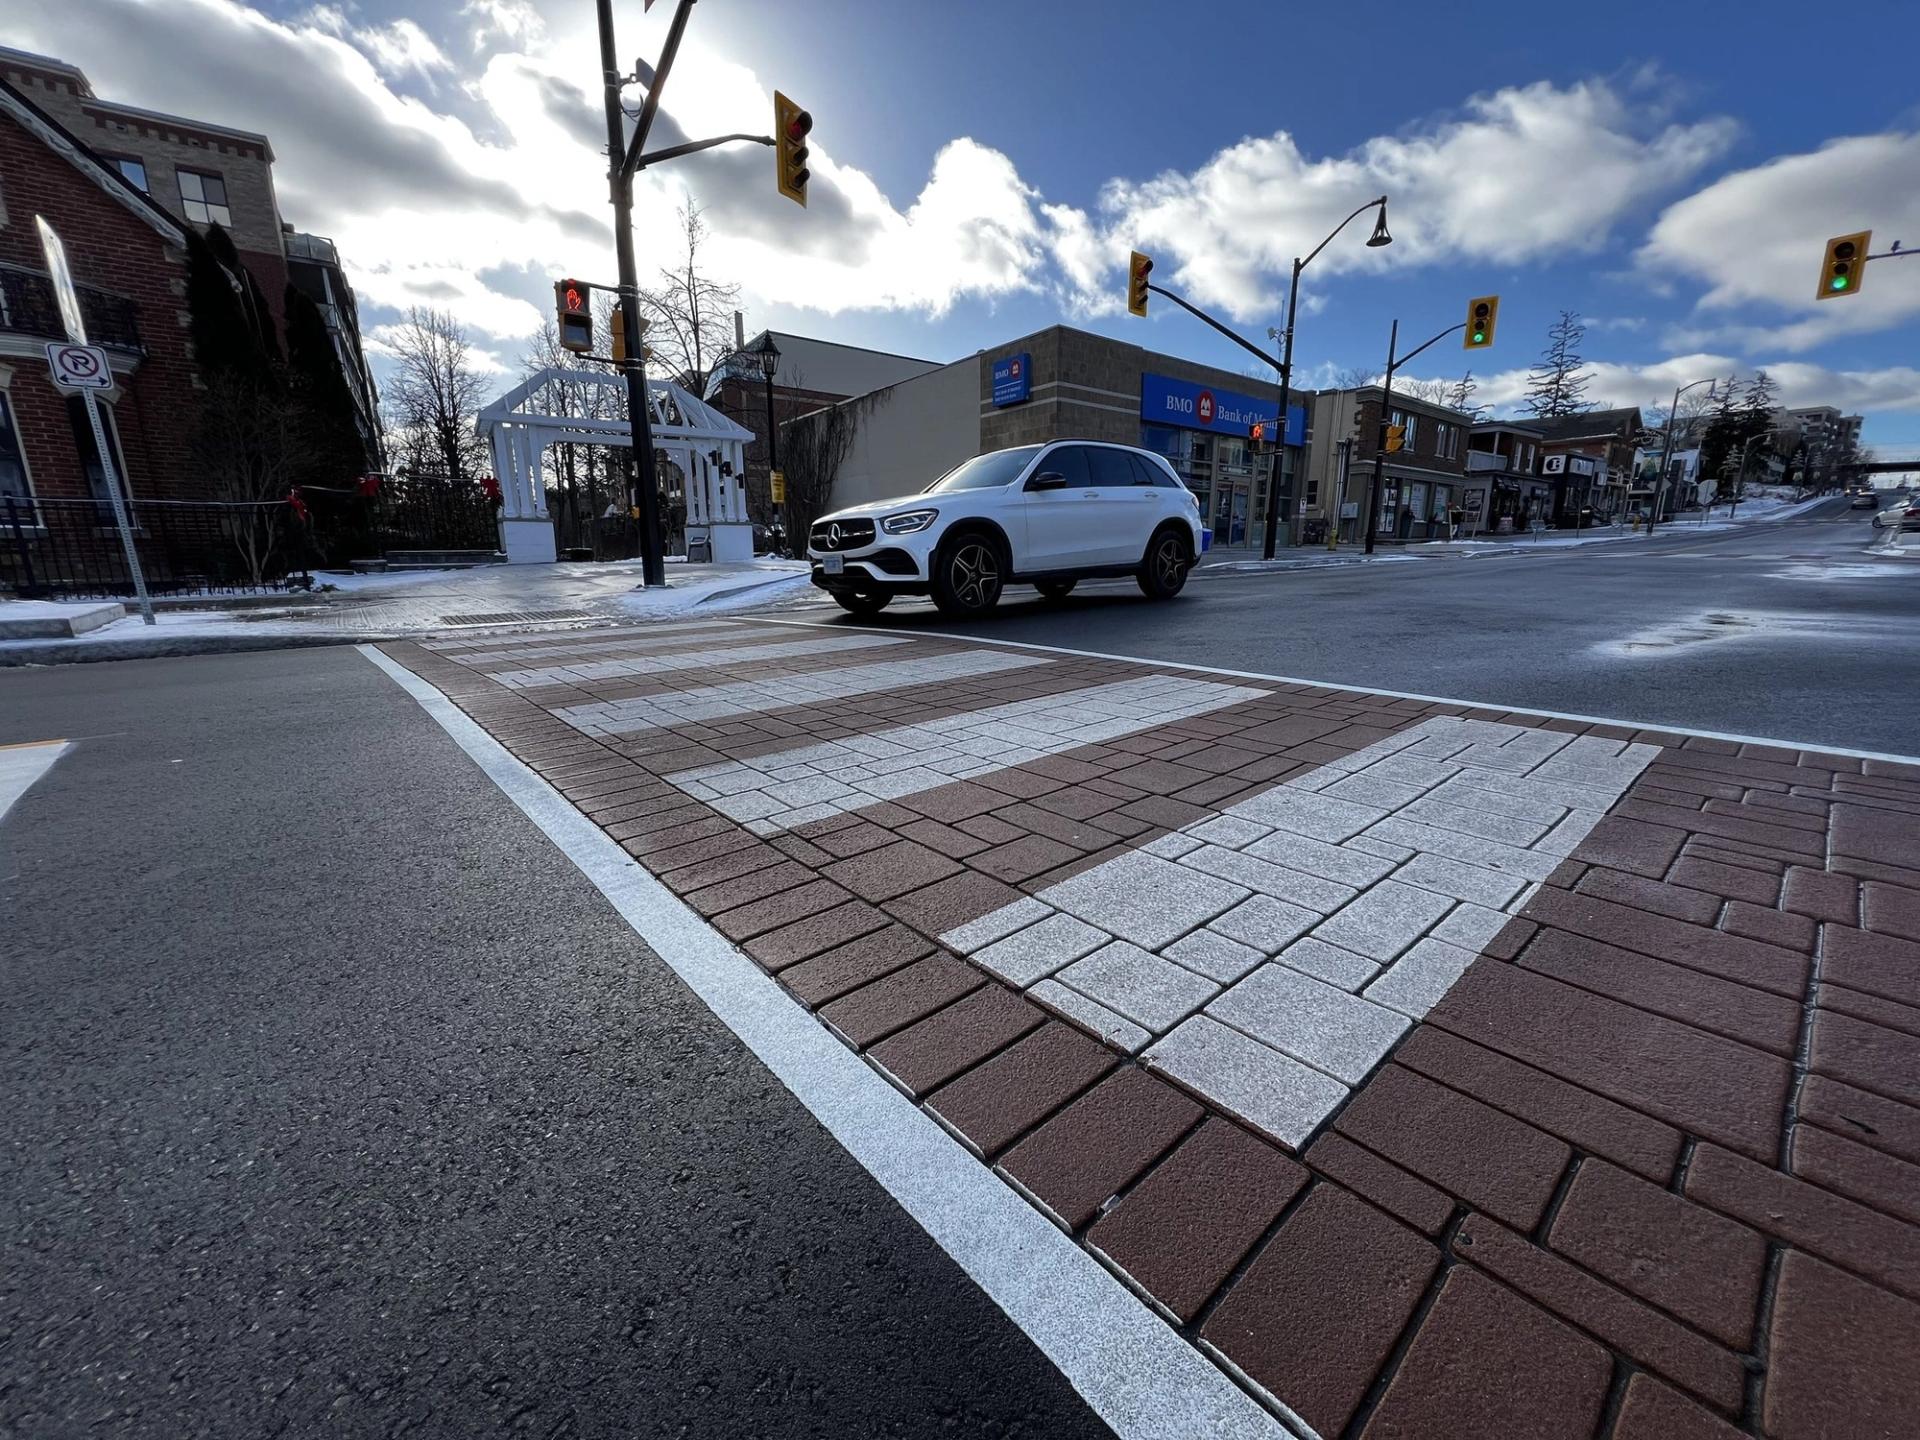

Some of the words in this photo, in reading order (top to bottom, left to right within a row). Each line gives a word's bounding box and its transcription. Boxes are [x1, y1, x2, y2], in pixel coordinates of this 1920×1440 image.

[1166, 395, 1193, 413] BMO
[1218, 405, 1242, 423] Bank
[1243, 411, 1253, 425] of
